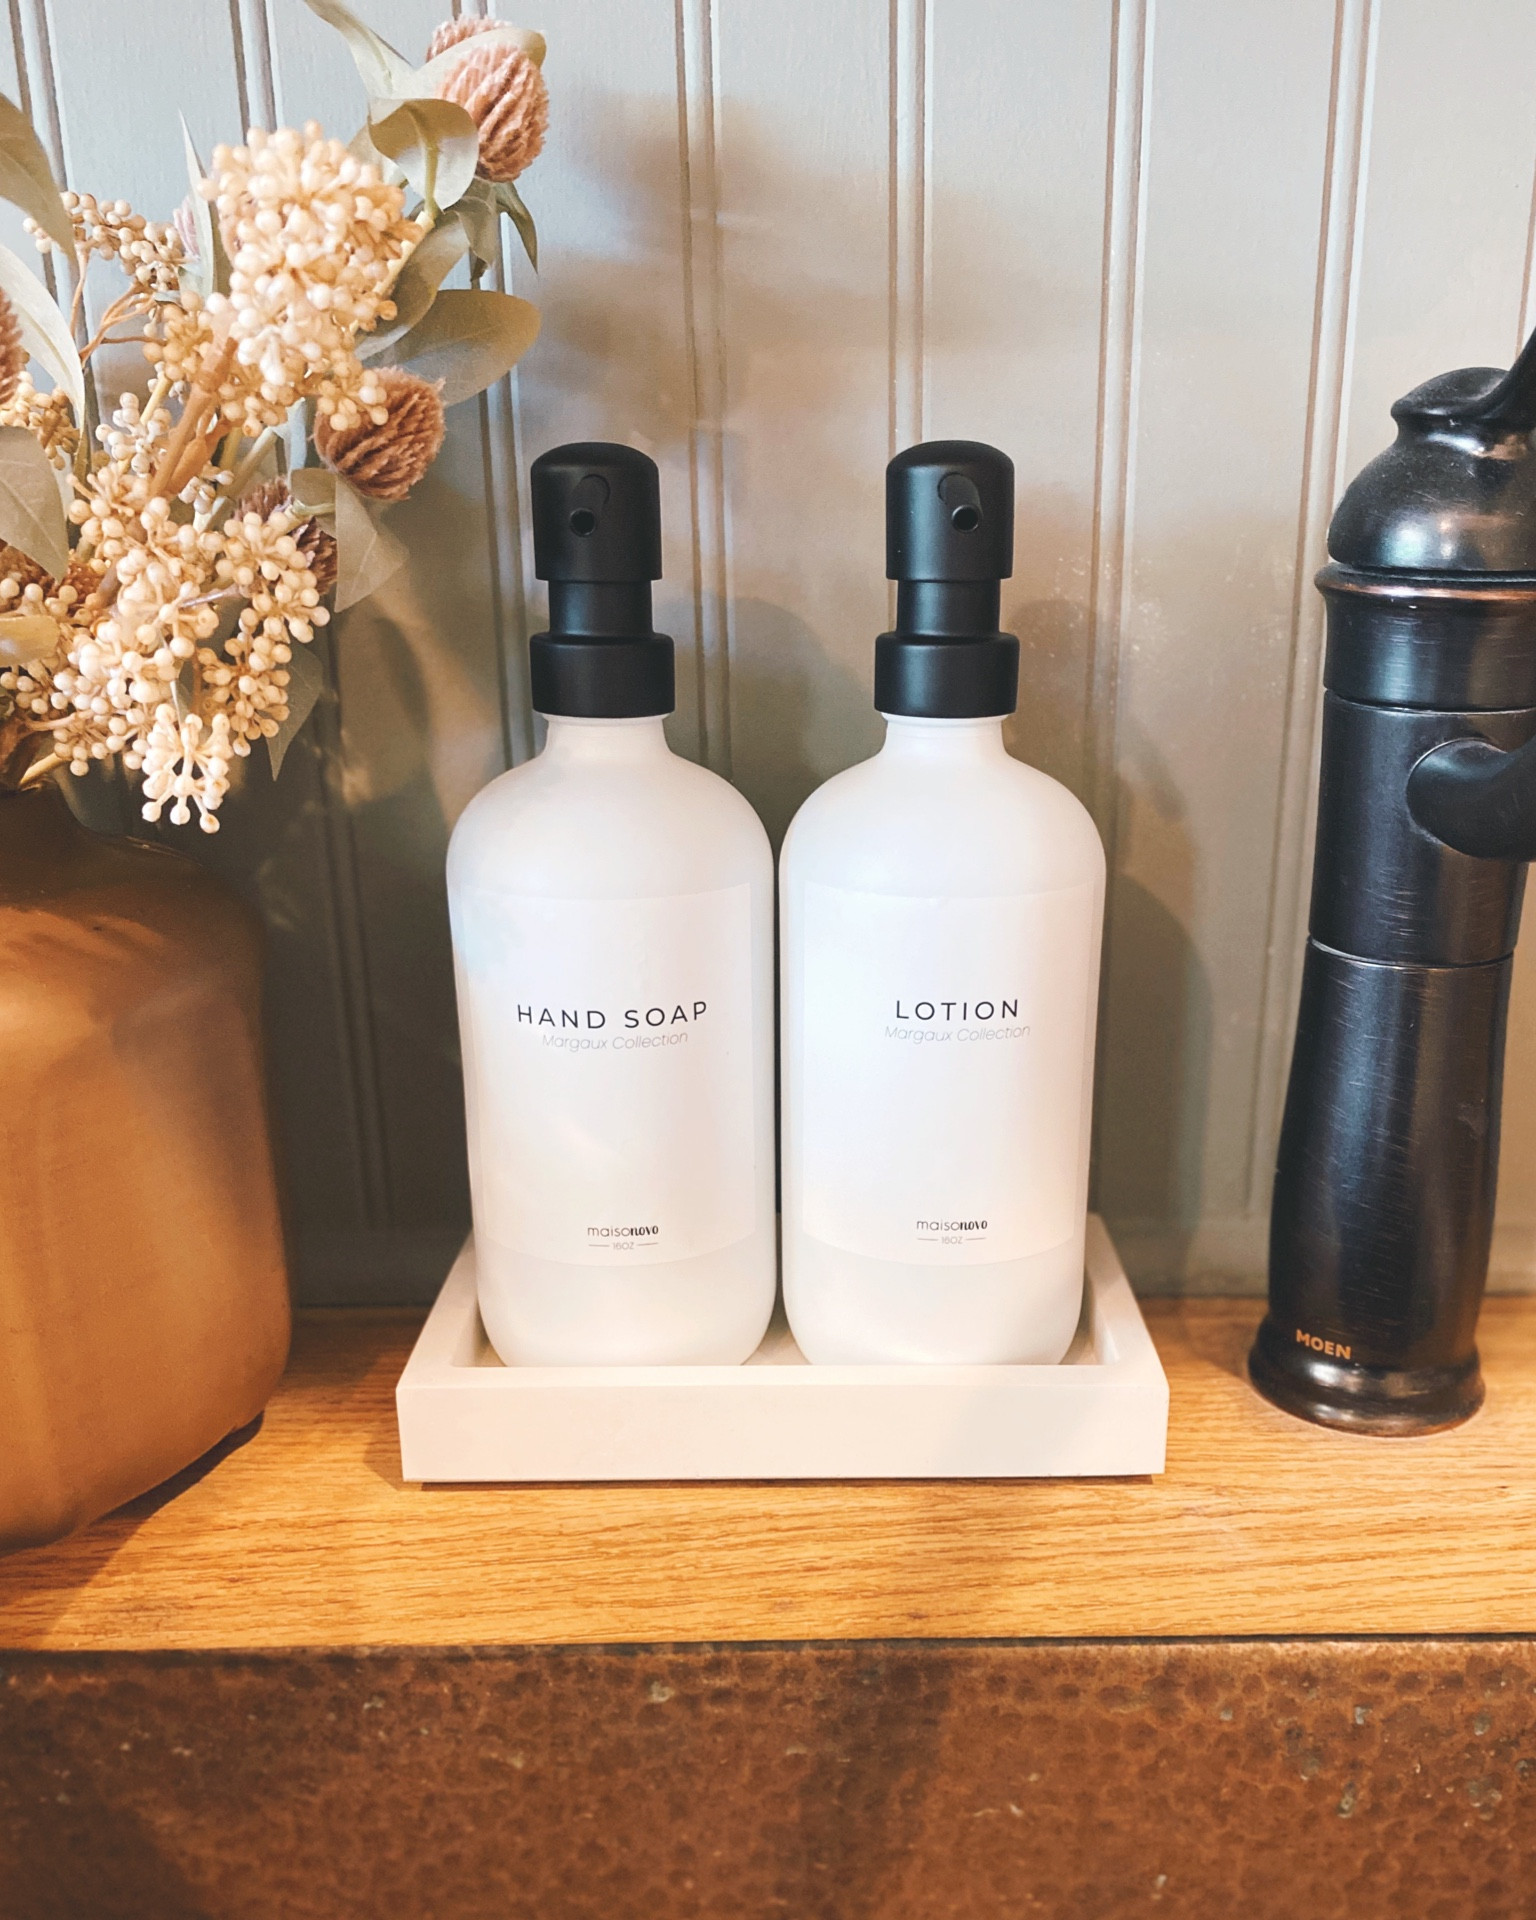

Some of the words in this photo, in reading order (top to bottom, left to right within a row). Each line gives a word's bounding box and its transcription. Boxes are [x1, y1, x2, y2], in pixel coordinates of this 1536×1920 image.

[517, 1004, 606, 1029] HAND
[624, 1001, 707, 1029] SOAP
[896, 999, 1018, 1021] LOTION
[542, 1033, 608, 1053] Margaux
[612, 1031, 689, 1050] Collection
[884, 1025, 952, 1045] Margaux
[956, 1024, 1031, 1042] Collection
[1296, 1328, 1352, 1360] MOEN
